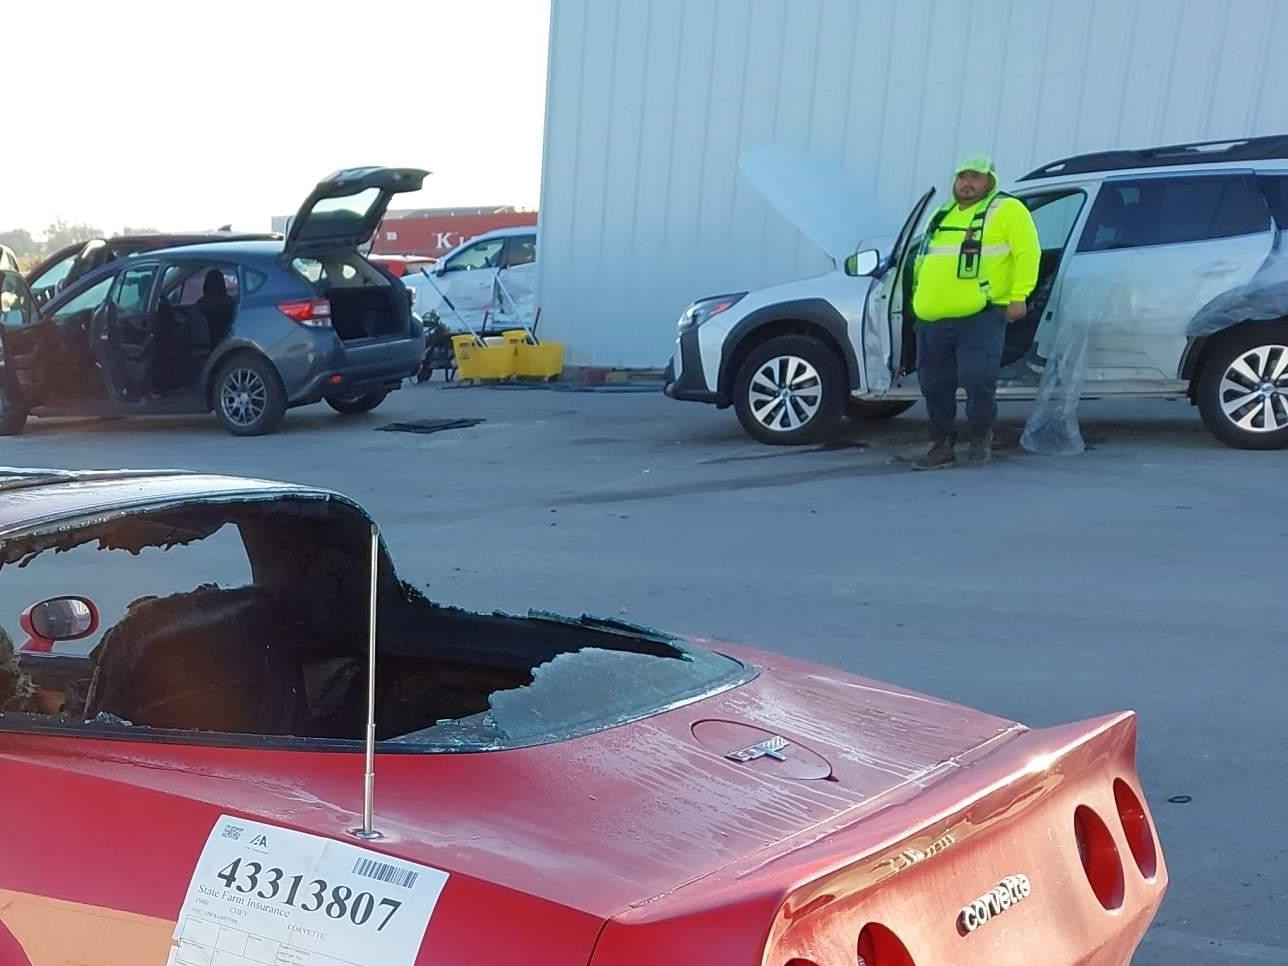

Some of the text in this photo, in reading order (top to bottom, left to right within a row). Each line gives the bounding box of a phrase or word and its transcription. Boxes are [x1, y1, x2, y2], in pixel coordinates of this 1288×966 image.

[198, 884, 220, 899] State
[222, 891, 245, 905] Farm
[246, 898, 291, 918] Insurance
[217, 857, 402, 932] 43313807
[287, 923, 326, 940] CORVETTE
